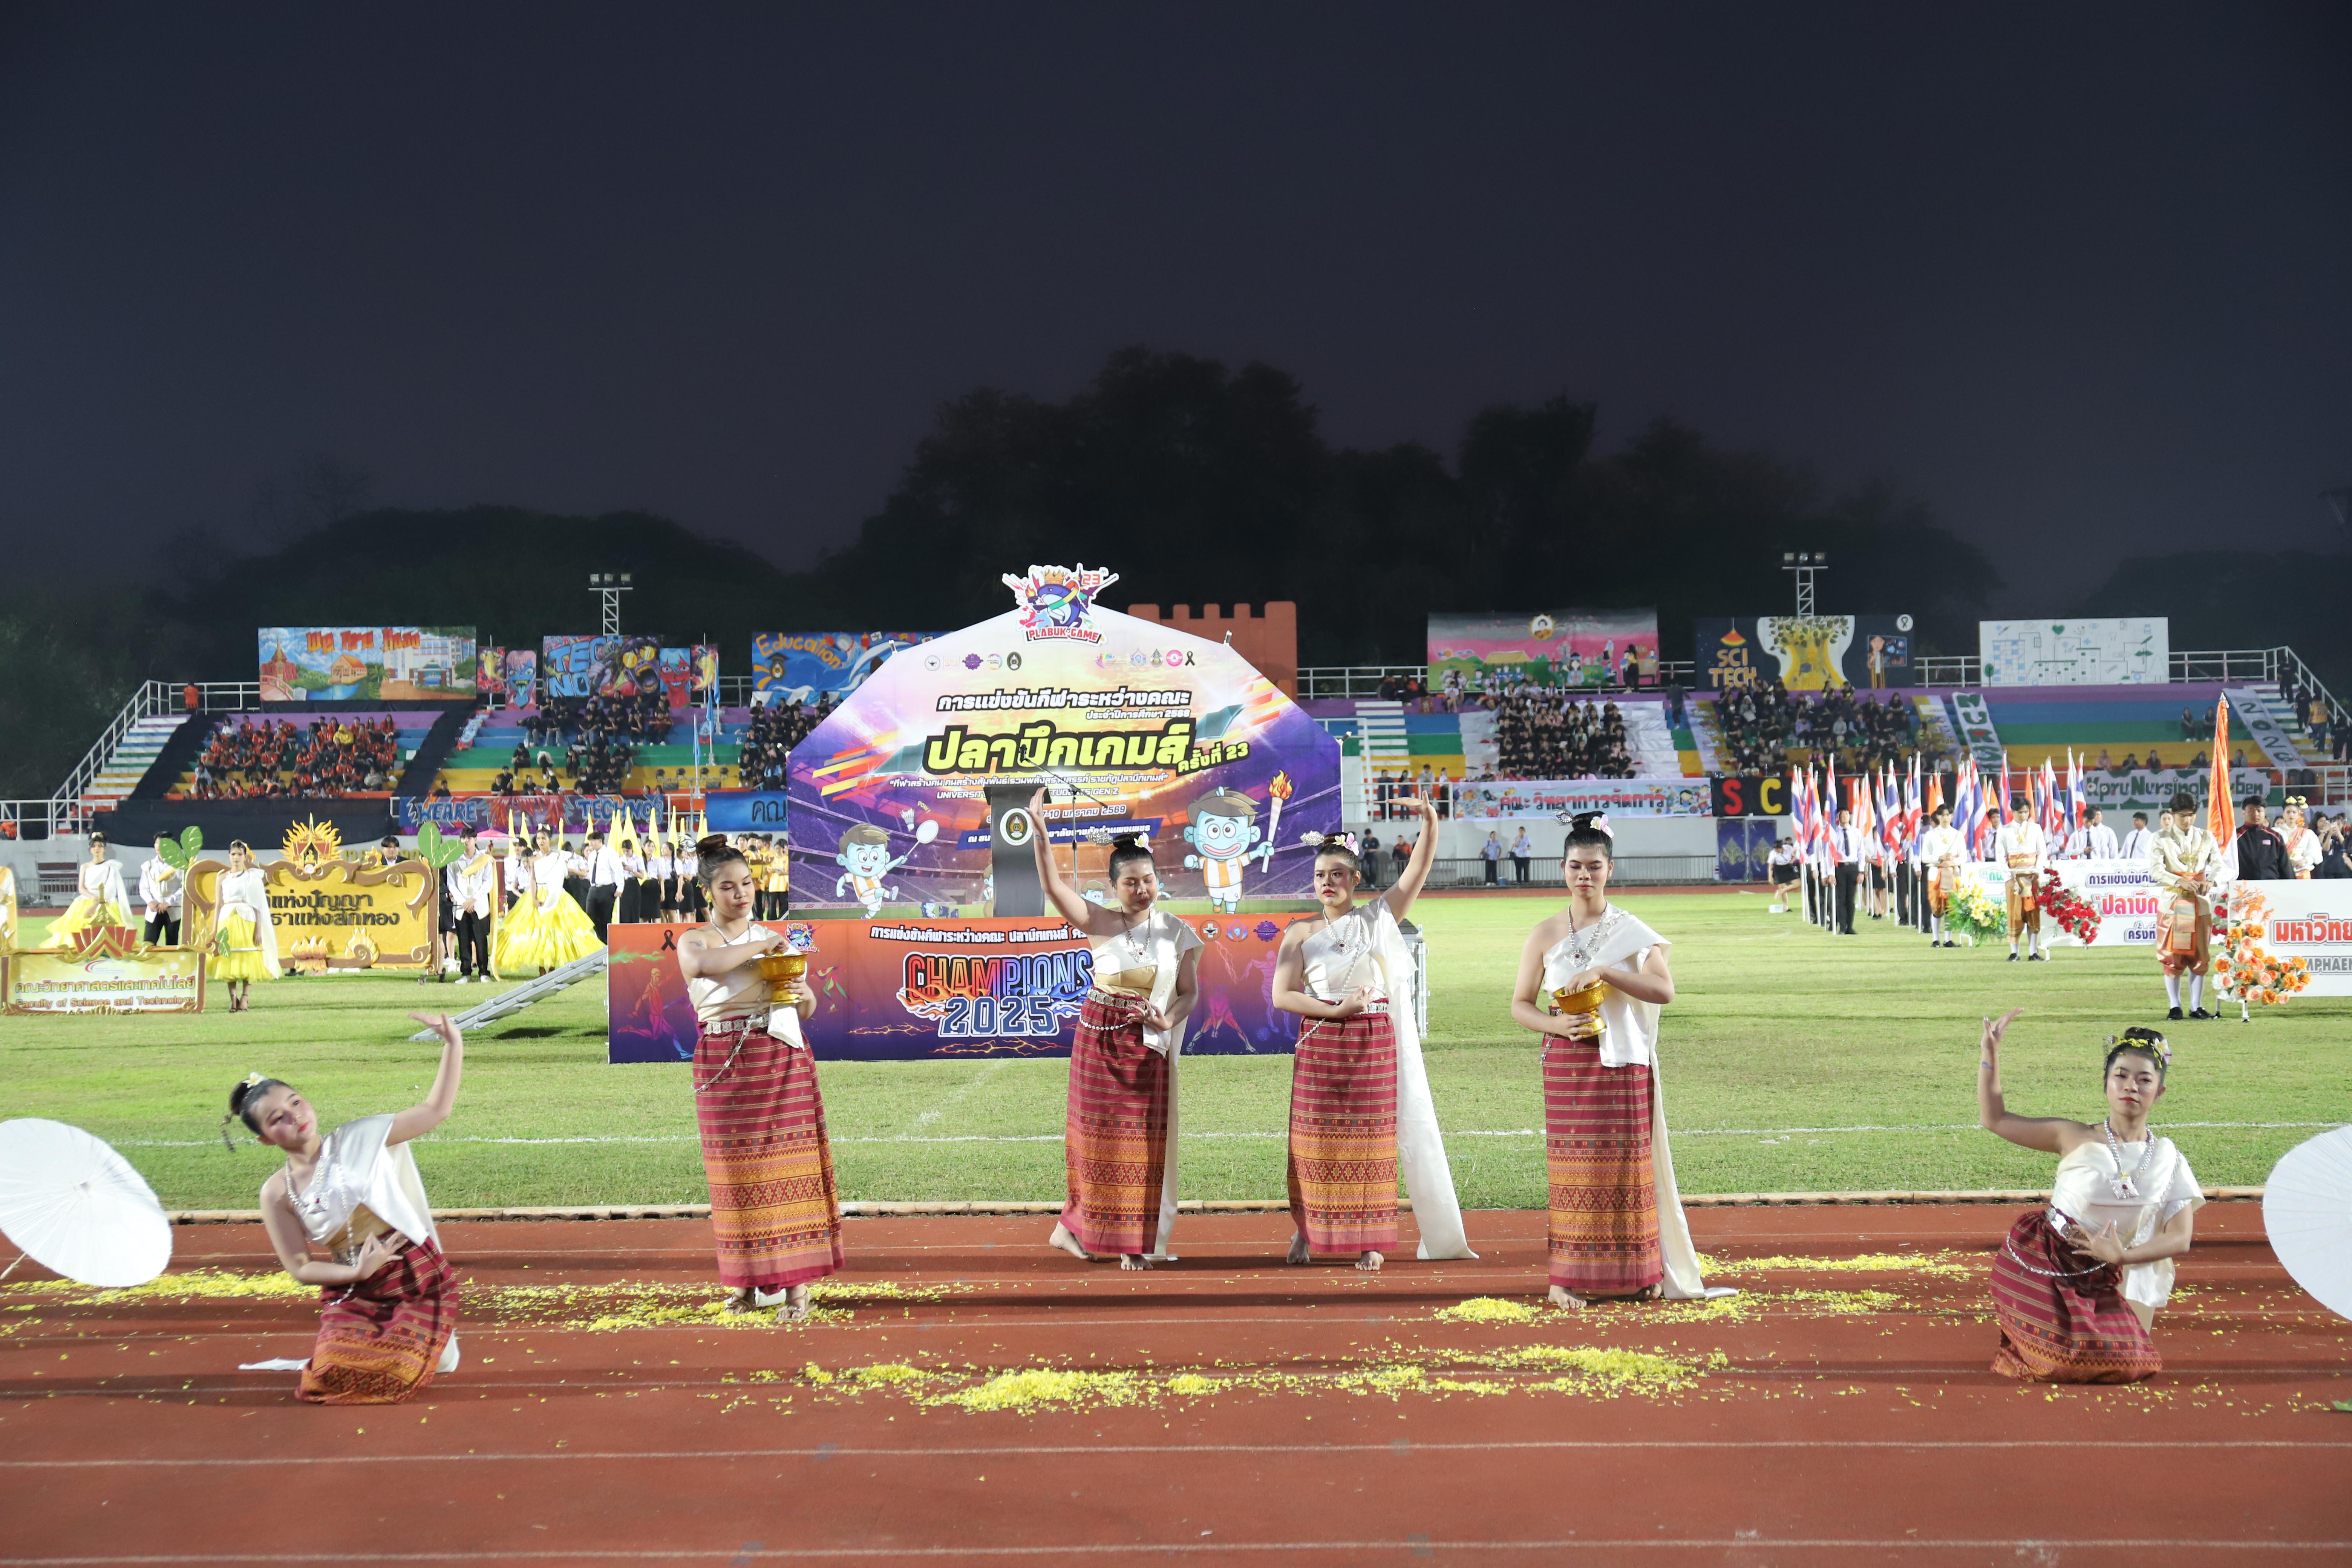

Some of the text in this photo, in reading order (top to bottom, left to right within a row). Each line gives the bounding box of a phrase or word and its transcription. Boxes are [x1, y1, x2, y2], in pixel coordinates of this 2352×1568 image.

[1082, 574, 1101, 585] 23
[1029, 628, 1099, 641] PLABUK GAME
[755, 632, 842, 669] Education
[1717, 648, 1748, 667] SCI
[1709, 666, 1757, 688] TECH
[937, 687, 1191, 711] การแข่งขันกีฬาระหว่างคณะ
[1086, 709, 1191, 720] ประจำปีการศึกษา 2568
[927, 723, 1190, 770] ปลาบึกเกมส์
[1178, 742, 1249, 772] ครั้งที่ 23
[1722, 779, 1743, 815] S
[1761, 778, 1782, 814] C
[1101, 805, 1127, 815] 2569
[871, 926, 1005, 943] การแข่งขันกีฬาระหว่างคณะ
[15, 975, 195, 993] คณะวิทยาศาสตร์และเทคโนโลยี
[907, 949, 1092, 1000] CHAMPIONS
[16, 997, 53, 1009] Faculty
[56, 998, 67, 1008] of
[69, 997, 111, 1007] Science
[114, 996, 133, 1006] and
[941, 995, 1058, 1035] 2025
